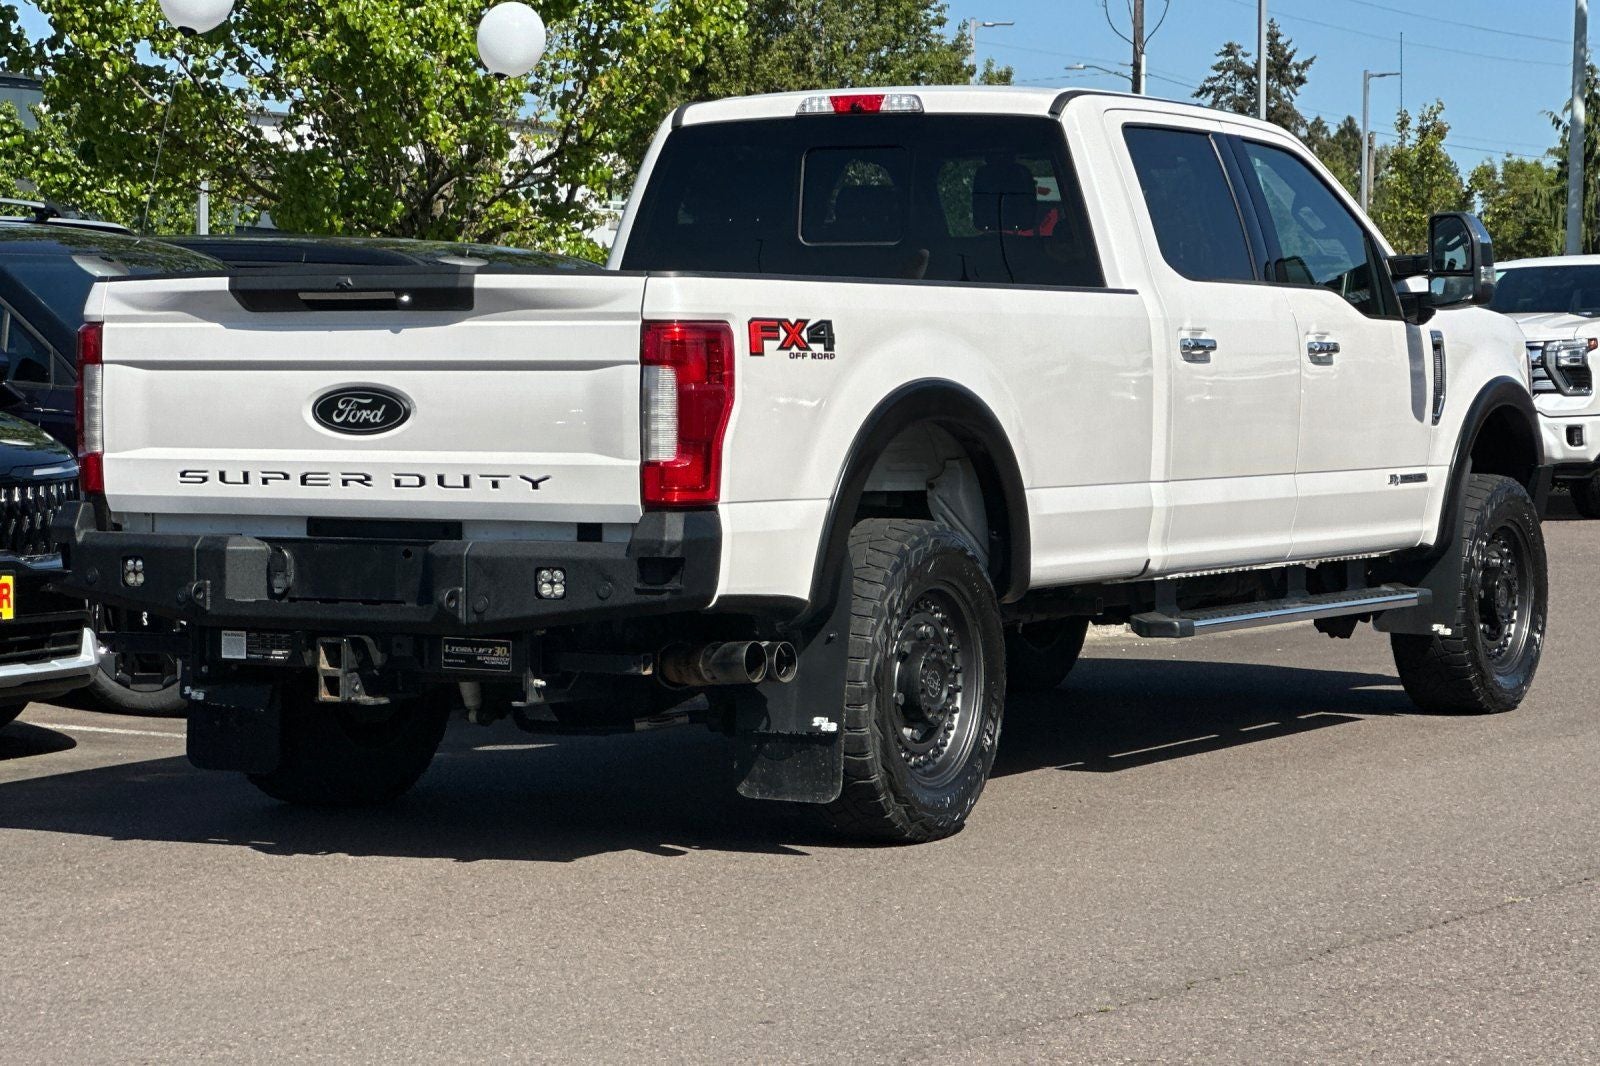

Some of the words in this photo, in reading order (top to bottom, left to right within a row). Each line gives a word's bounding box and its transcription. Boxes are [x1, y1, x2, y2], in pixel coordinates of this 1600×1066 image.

[747, 317, 835, 356] FX4
[789, 352, 808, 360] OFF
[811, 352, 836, 360] ROAD
[332, 397, 387, 423] Ford
[178, 469, 374, 488] SUPER
[391, 472, 552, 490] DUTY
